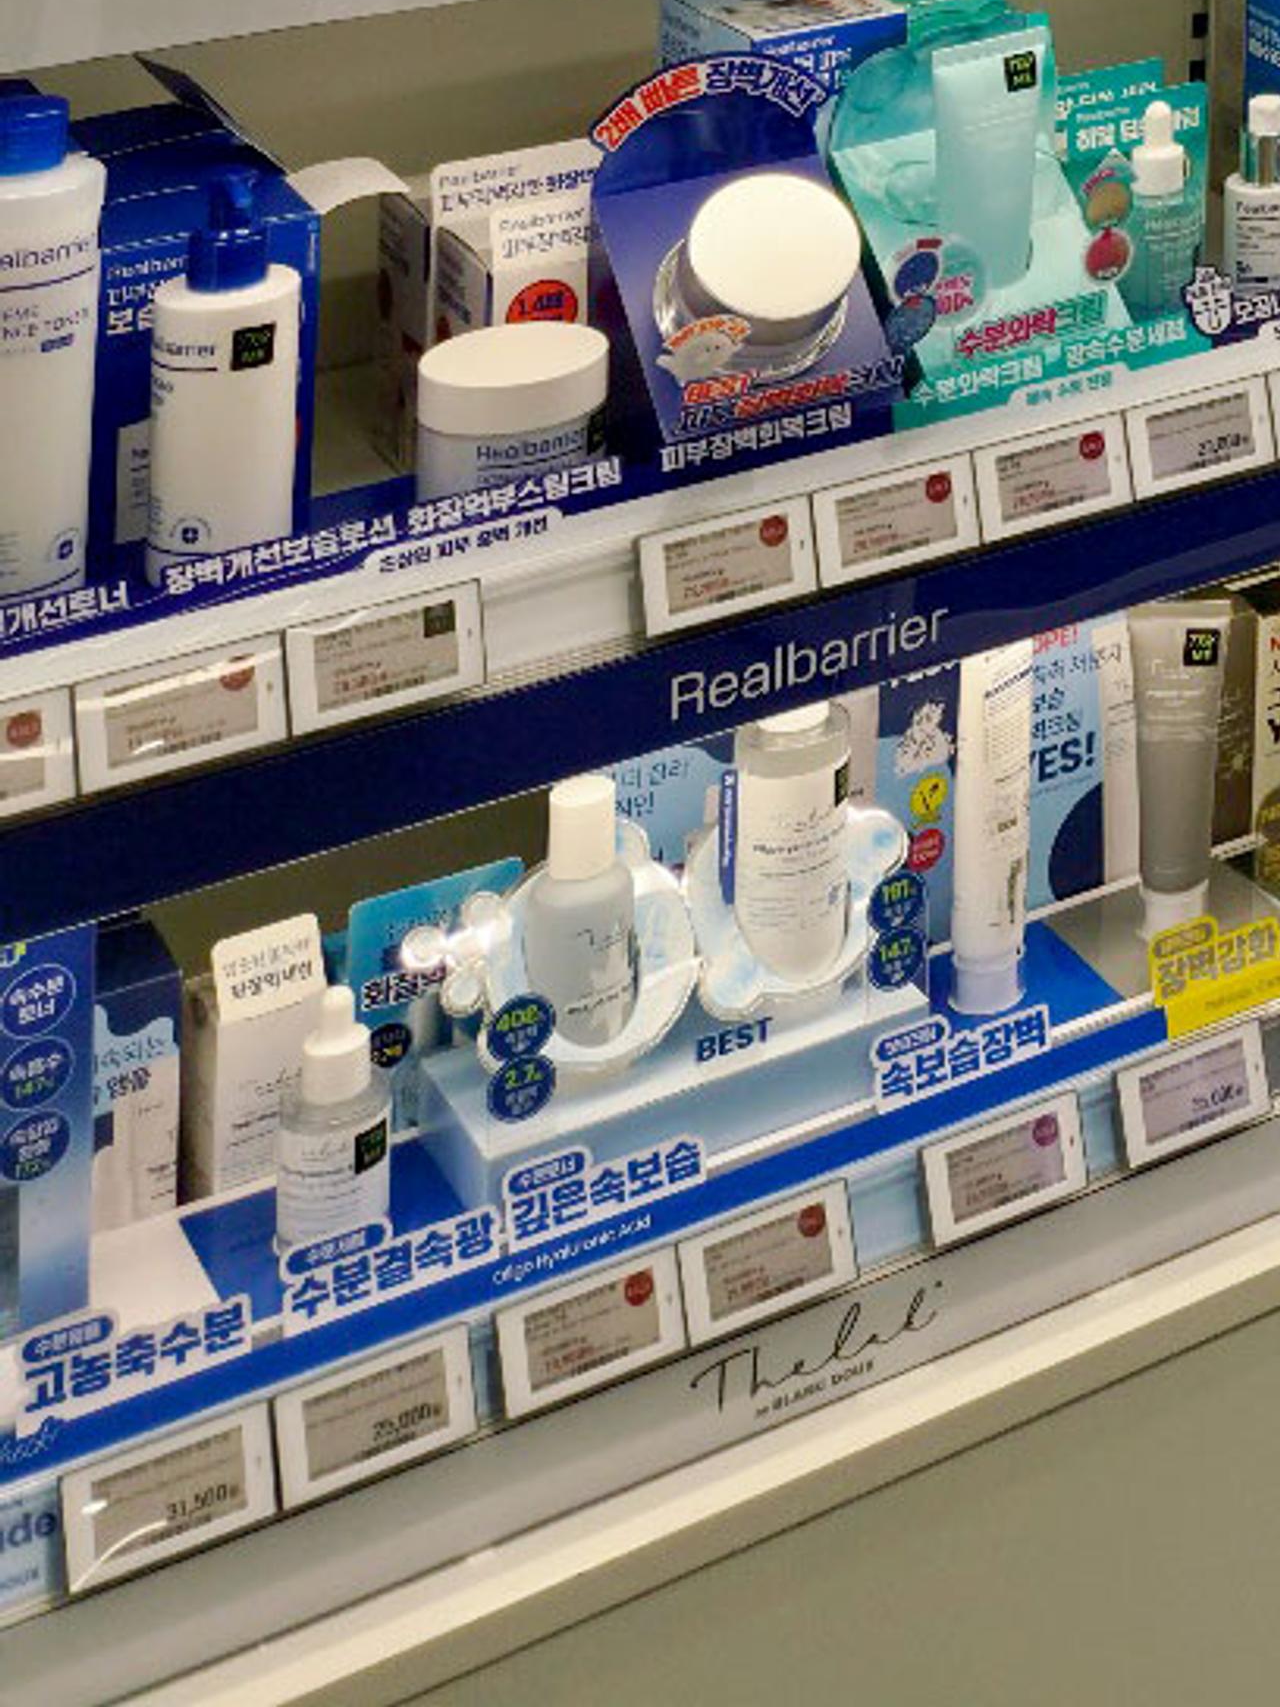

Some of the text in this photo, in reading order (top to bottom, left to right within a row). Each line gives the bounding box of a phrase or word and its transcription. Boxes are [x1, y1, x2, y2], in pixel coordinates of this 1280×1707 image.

[668, 601, 950, 722] Realbarrier
[696, 1015, 774, 1063] BEST
[511, 1140, 702, 1243] 깊은속보습
[290, 1212, 499, 1321] 수분결속광
[23, 1300, 248, 1416] 고농축수분
